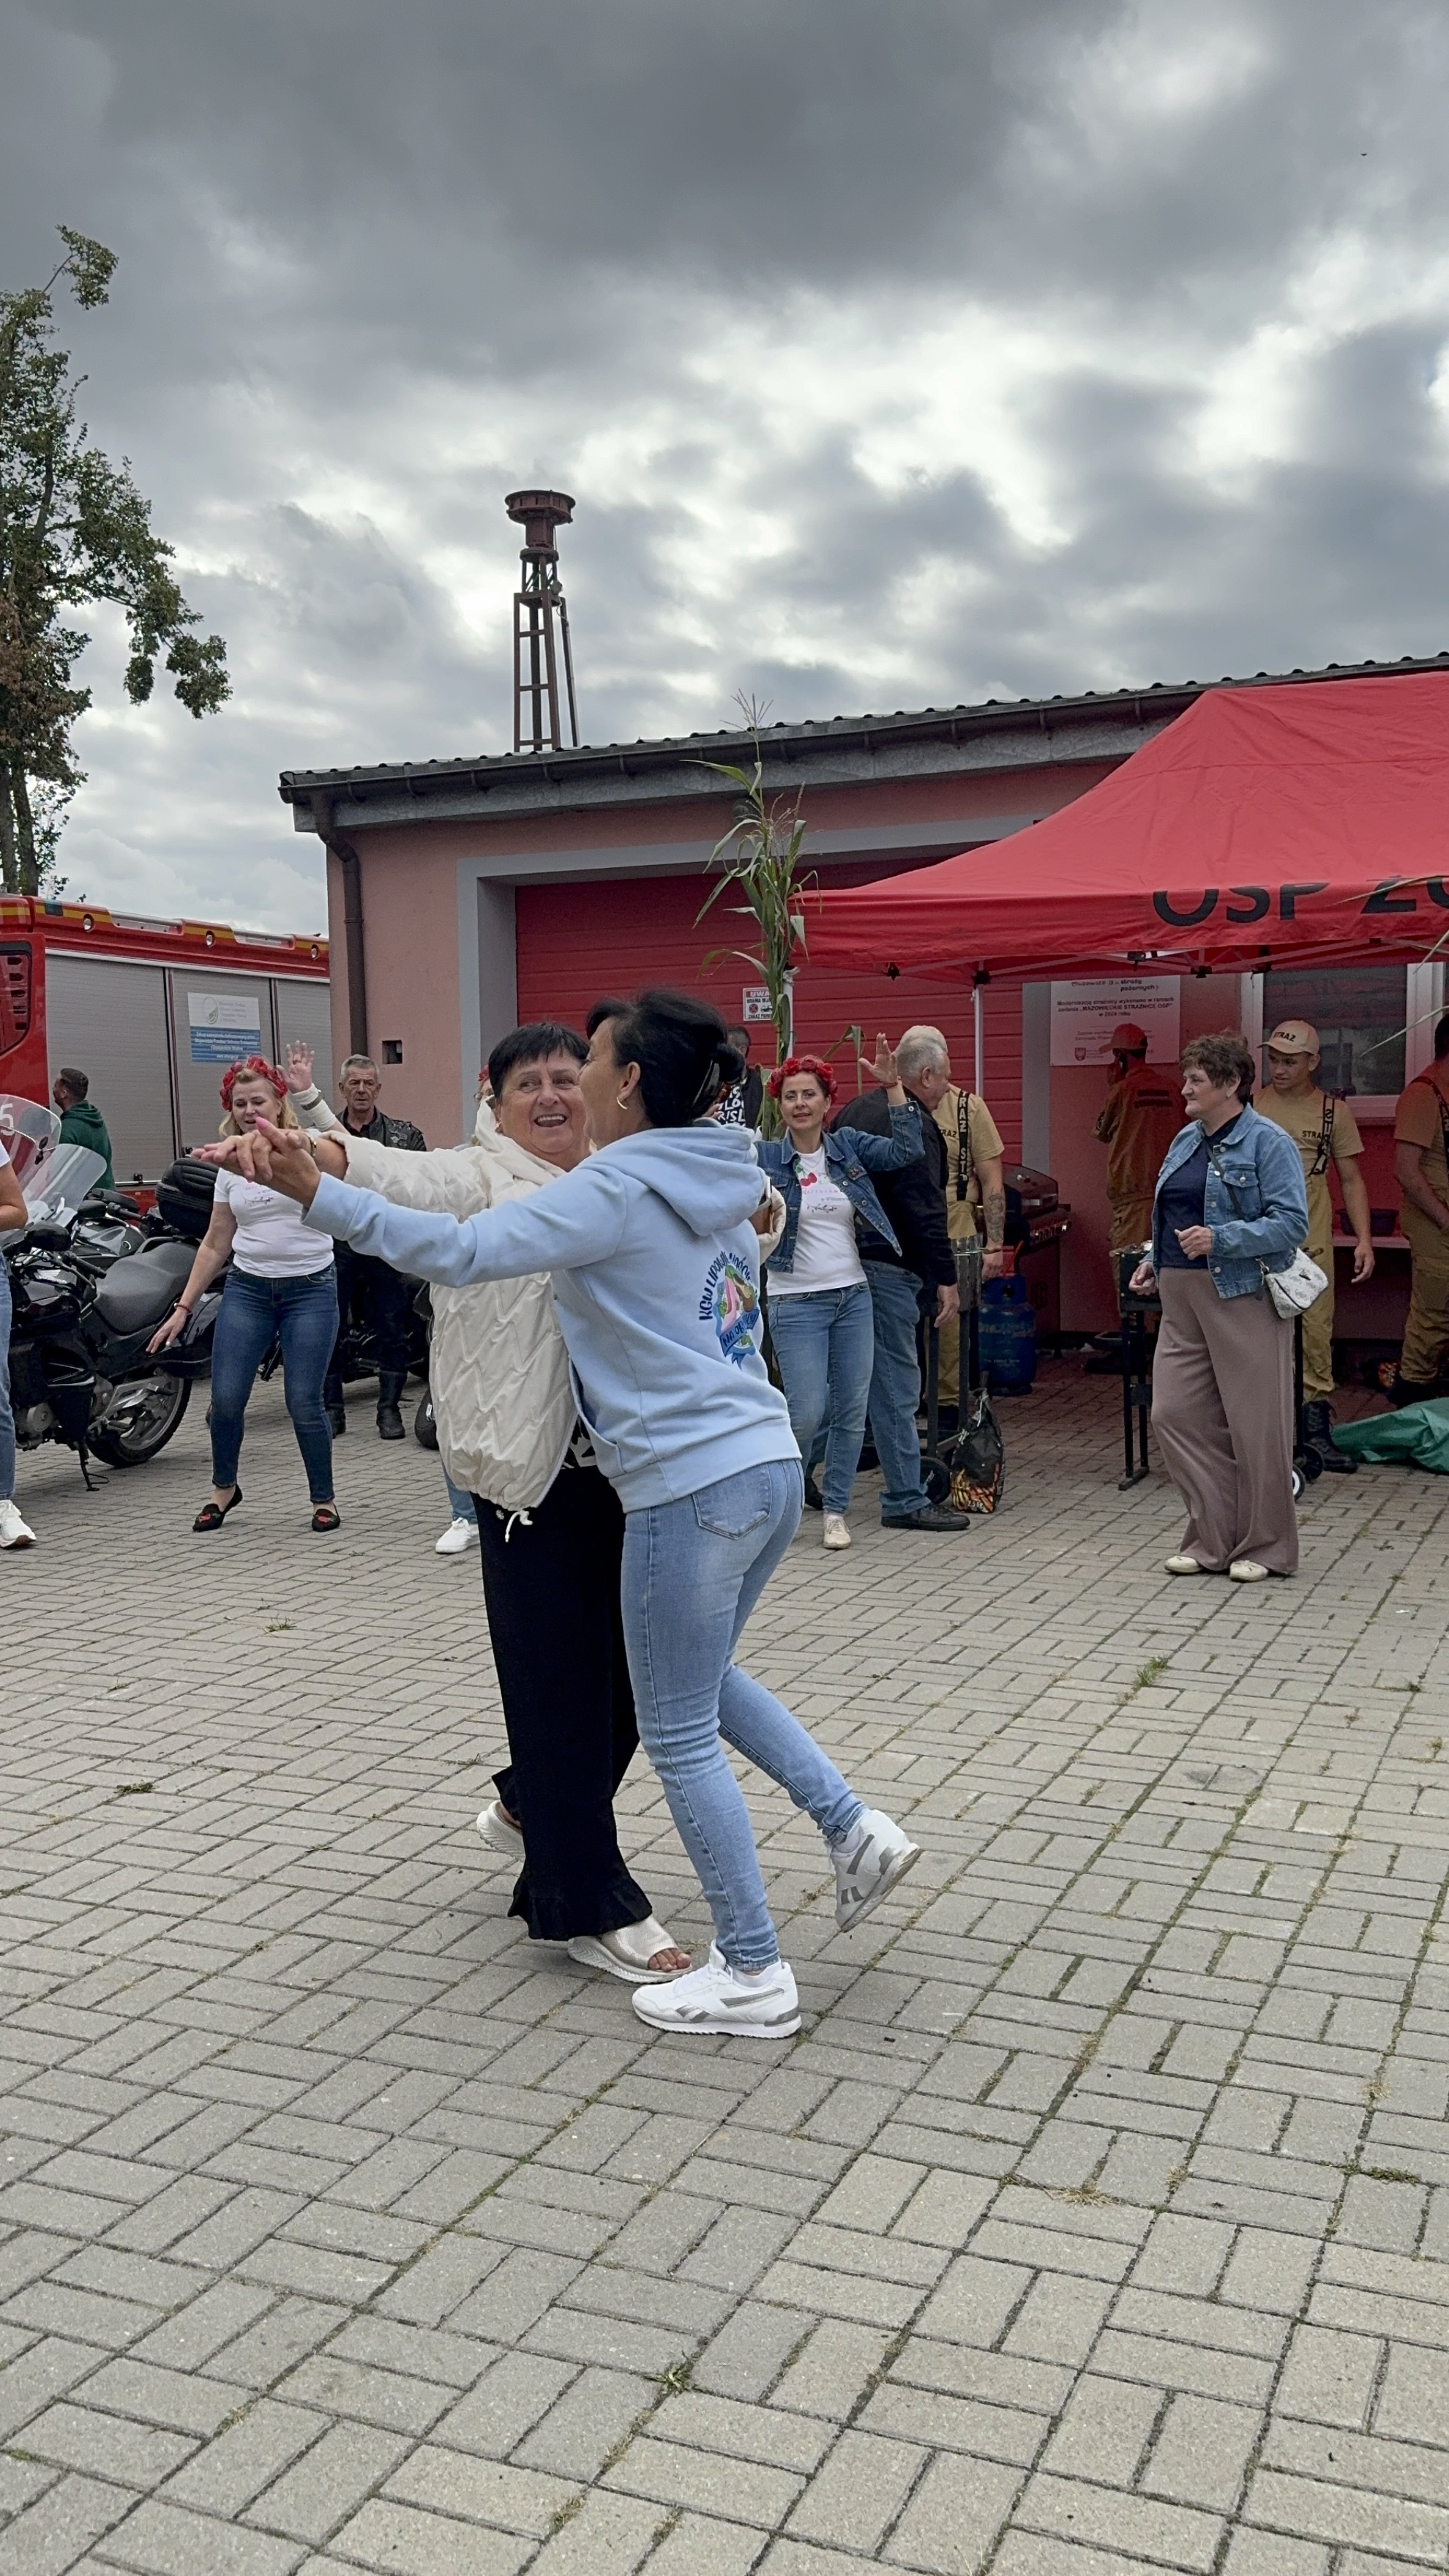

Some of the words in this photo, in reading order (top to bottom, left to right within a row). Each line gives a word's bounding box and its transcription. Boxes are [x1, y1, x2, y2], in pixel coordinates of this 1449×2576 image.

[1153, 882, 1330, 926] OSP
[1302, 1131, 1322, 1139] STRA
[699, 1287, 713, 1320] KGW
